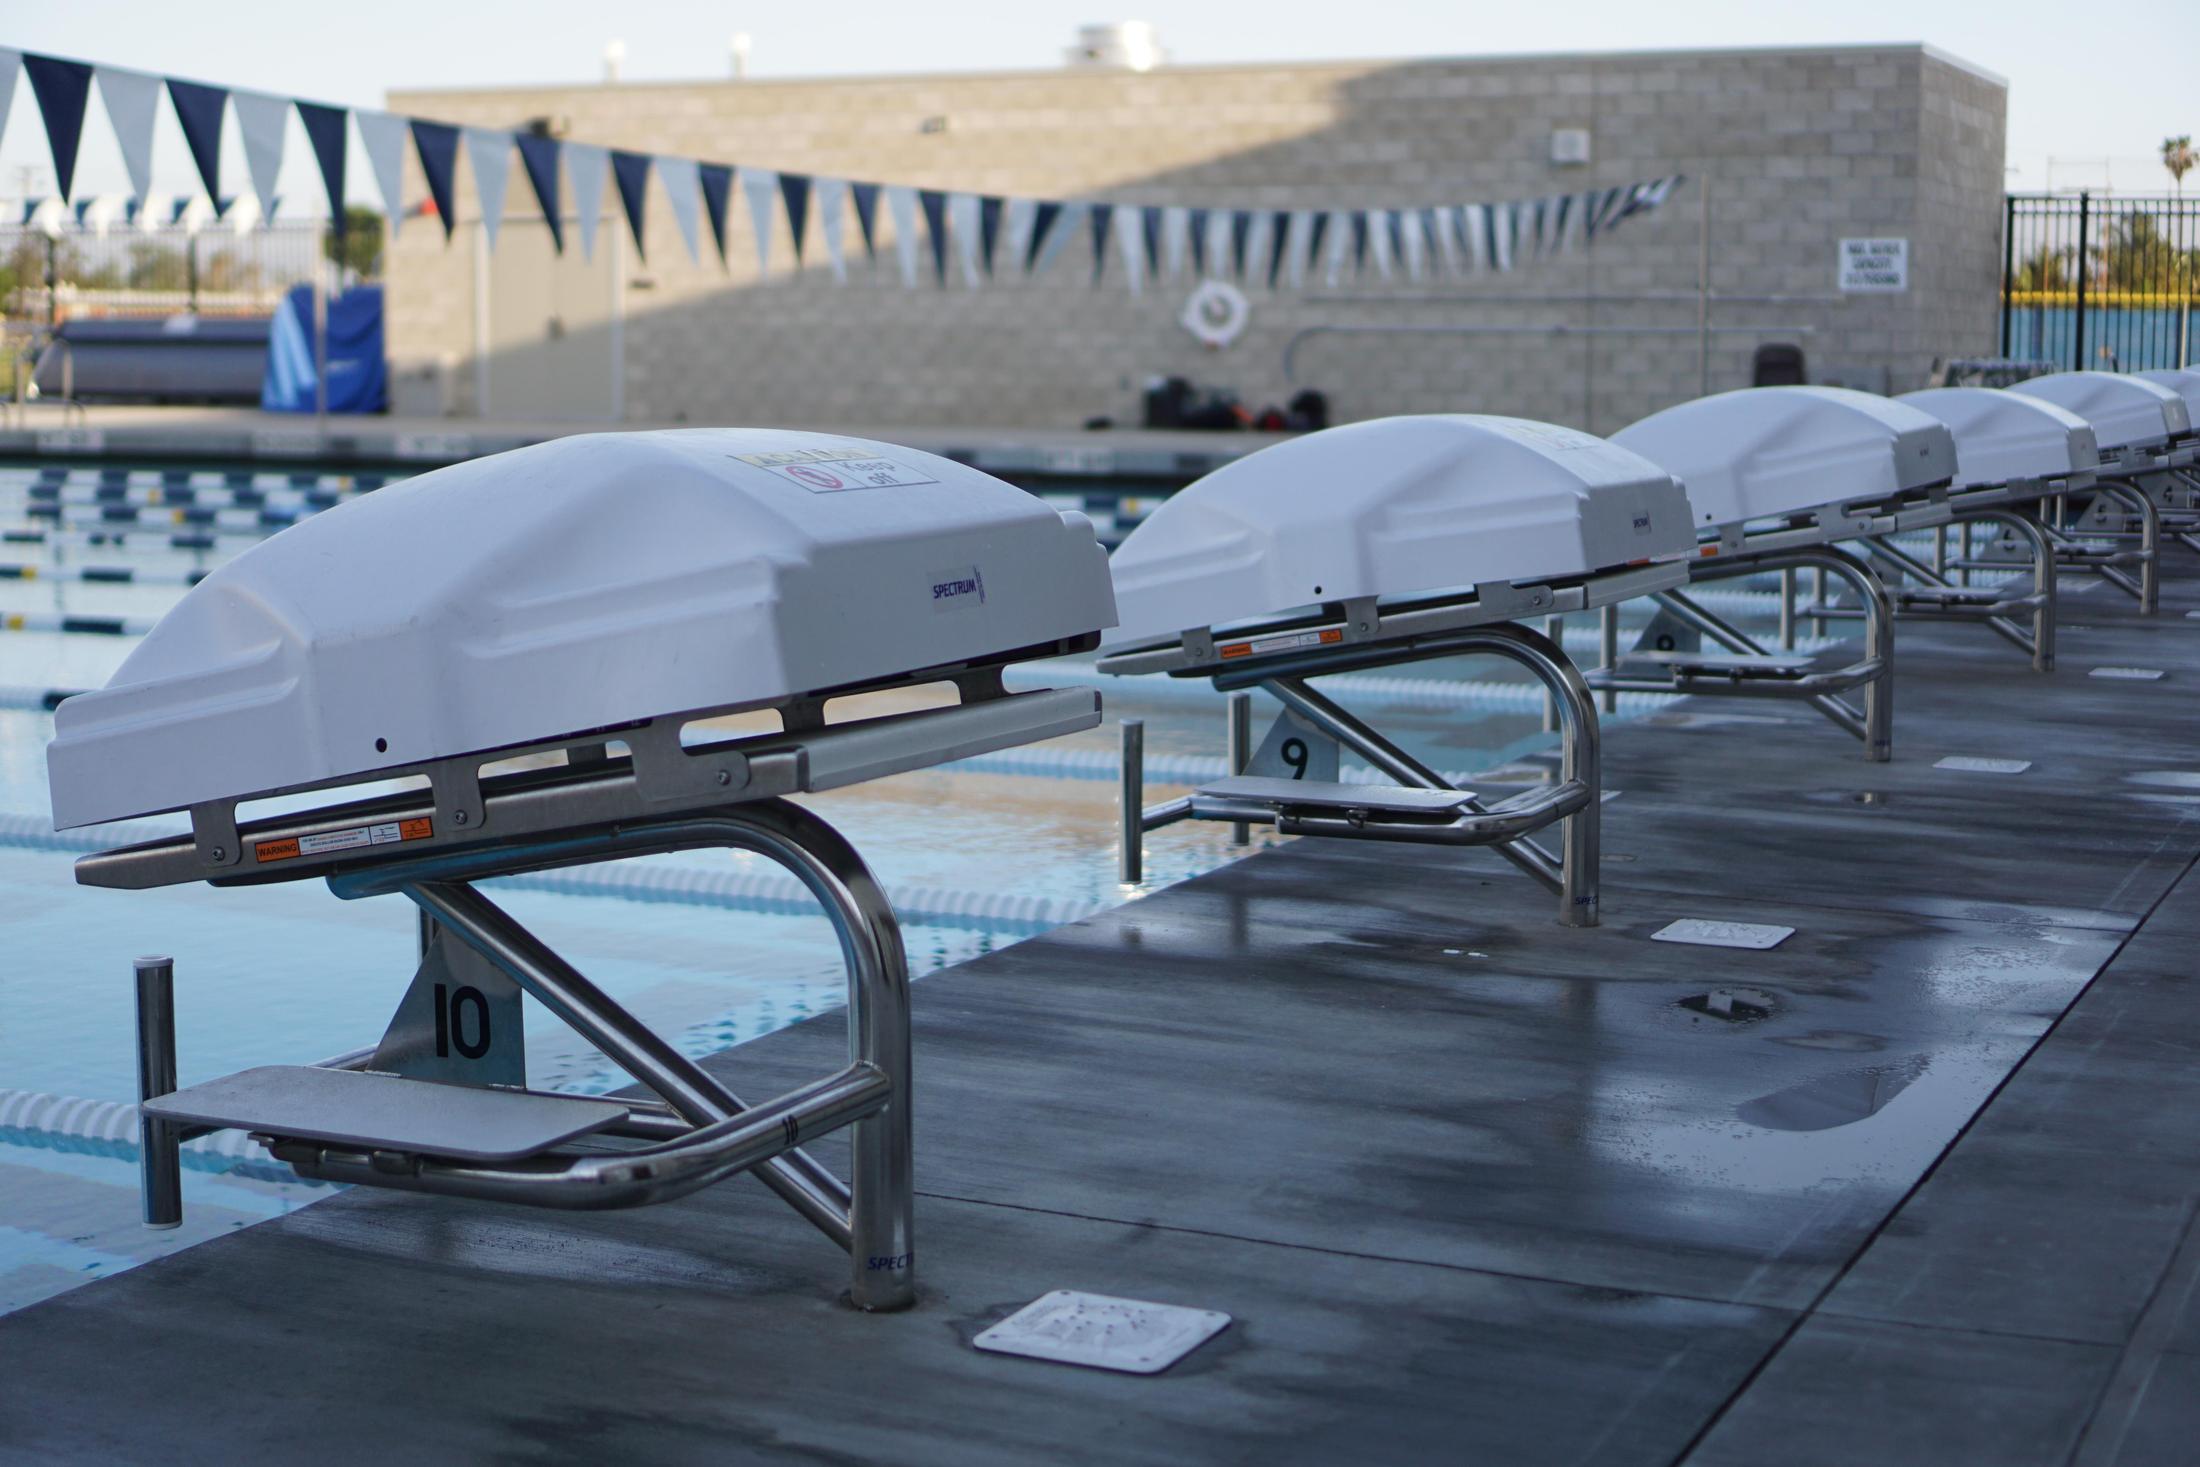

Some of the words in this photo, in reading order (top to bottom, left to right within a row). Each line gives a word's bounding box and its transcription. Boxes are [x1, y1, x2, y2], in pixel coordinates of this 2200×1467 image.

[835, 462, 896, 472] Keep
[867, 473, 900, 484] off
[933, 579, 977, 599] SPECTRUM
[1280, 737, 1308, 780] 9
[257, 843, 298, 858] WARNING
[434, 983, 491, 1059] 10
